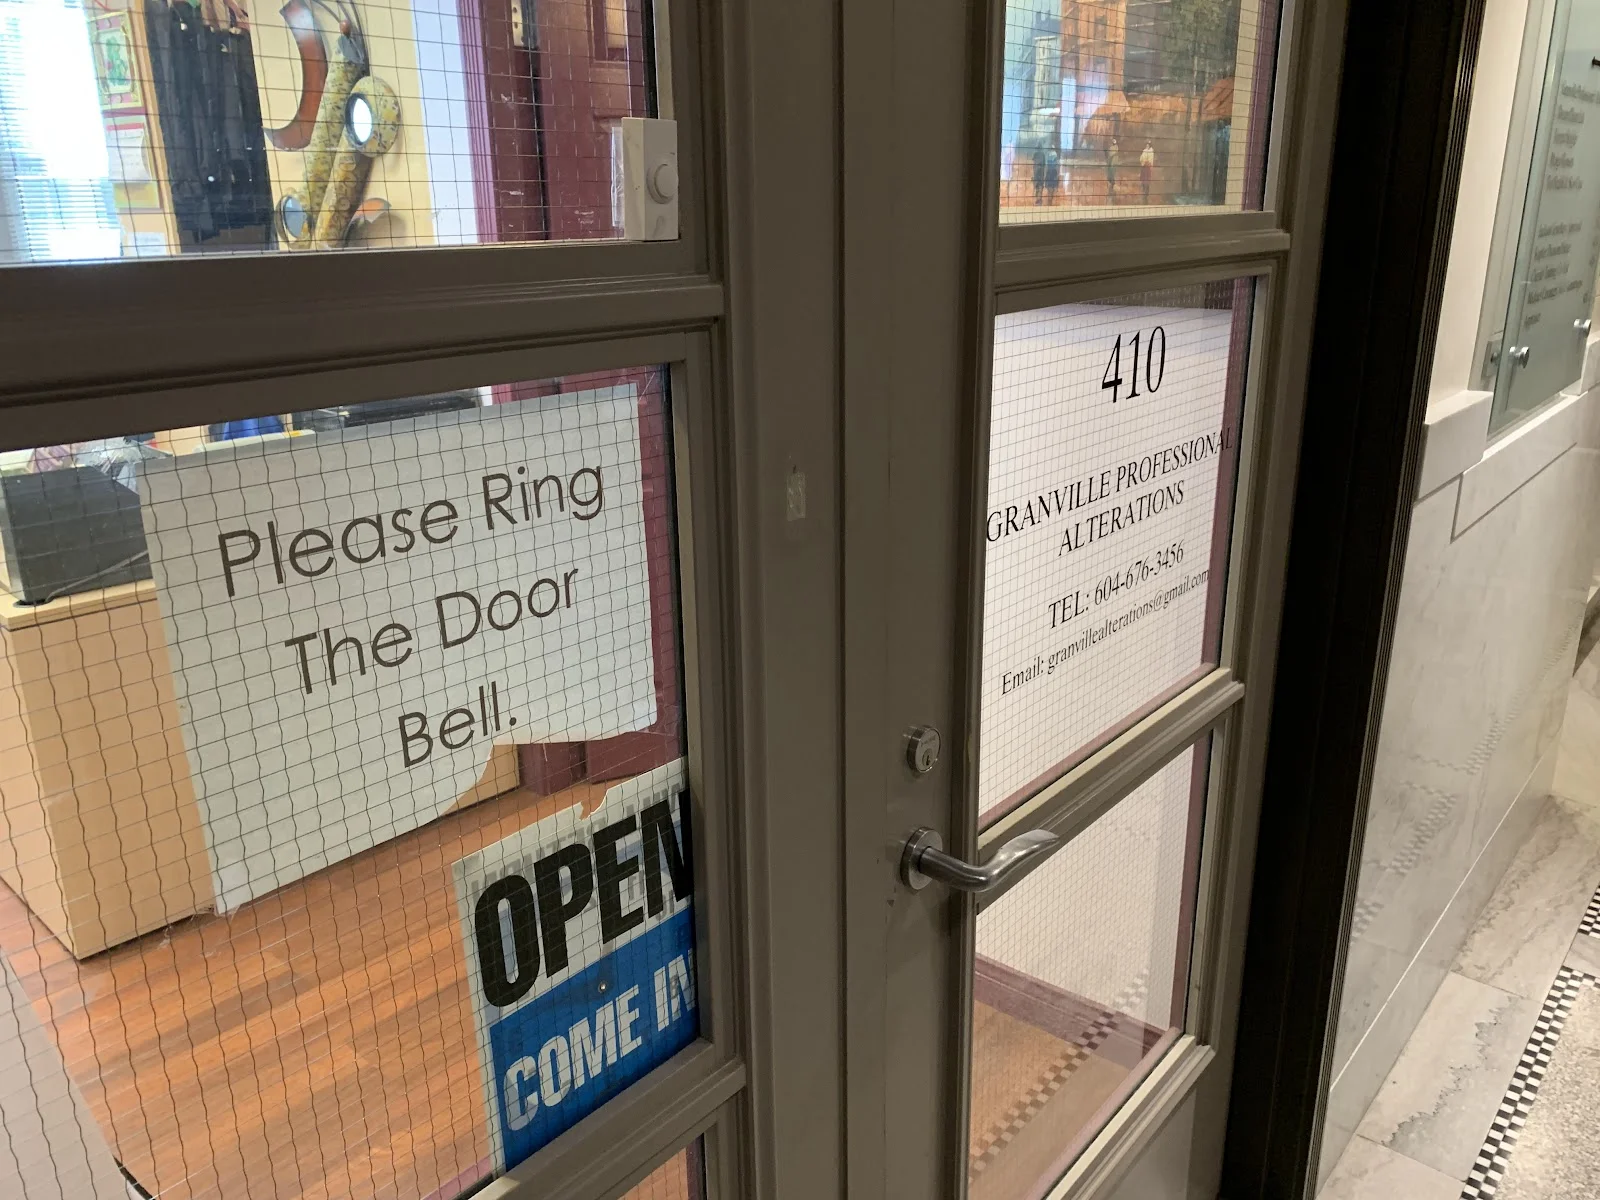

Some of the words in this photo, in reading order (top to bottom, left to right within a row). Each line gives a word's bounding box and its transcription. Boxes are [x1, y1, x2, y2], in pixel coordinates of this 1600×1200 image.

[1101, 326, 1166, 403] 410
[217, 499, 459, 597] Please
[482, 465, 604, 531] Ring
[986, 470, 1112, 542] GRANVILLE
[1115, 426, 1233, 493] PROFESSIONAL
[1058, 480, 1185, 556] ALTERATIONS
[285, 623, 413, 695] The
[436, 567, 579, 650] Door
[1001, 655, 1045, 696] Email:
[1048, 568, 1210, 675] granvillealterations@gmail.com
[1048, 589, 1090, 629] TEL:
[1094, 539, 1185, 606] 604-676-3456
[399, 681, 517, 768] Bell.
[474, 788, 695, 1008] OPEN
[503, 984, 642, 1132] COME
[653, 947, 697, 1032] IN
